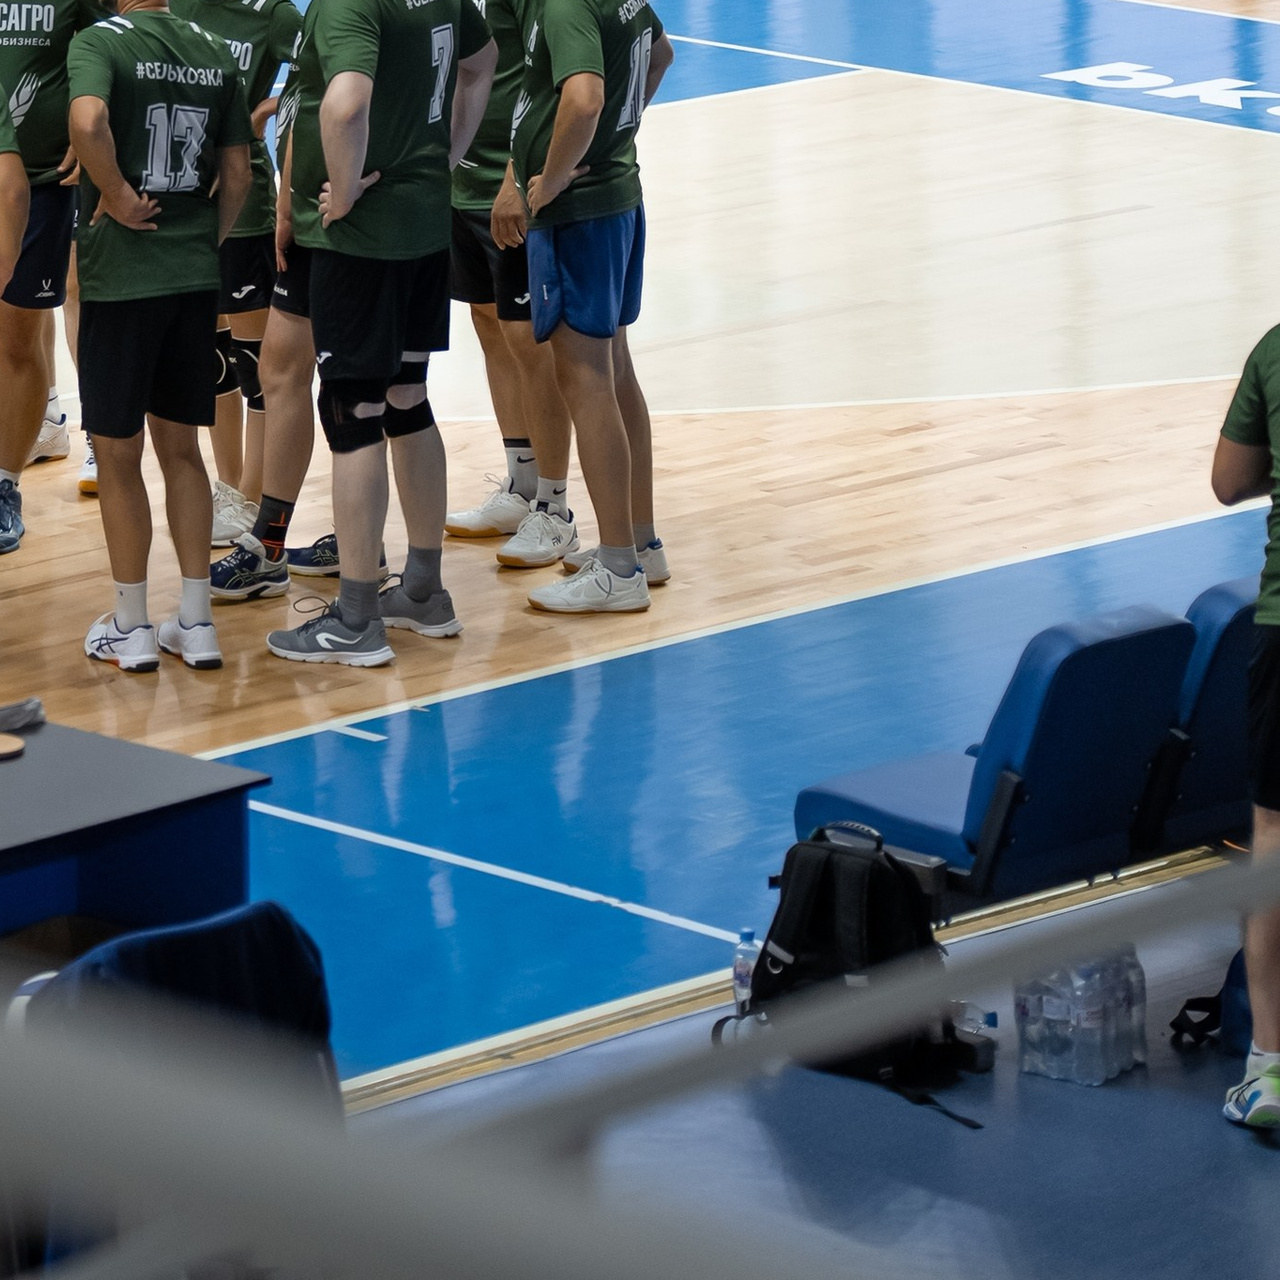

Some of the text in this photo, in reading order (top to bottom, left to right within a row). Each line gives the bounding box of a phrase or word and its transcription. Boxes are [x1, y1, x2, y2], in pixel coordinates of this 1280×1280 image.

[136, 62, 224, 88] #СЕЛЬХОЗКА
[427, 23, 455, 124] 7
[139, 102, 210, 193] 17
